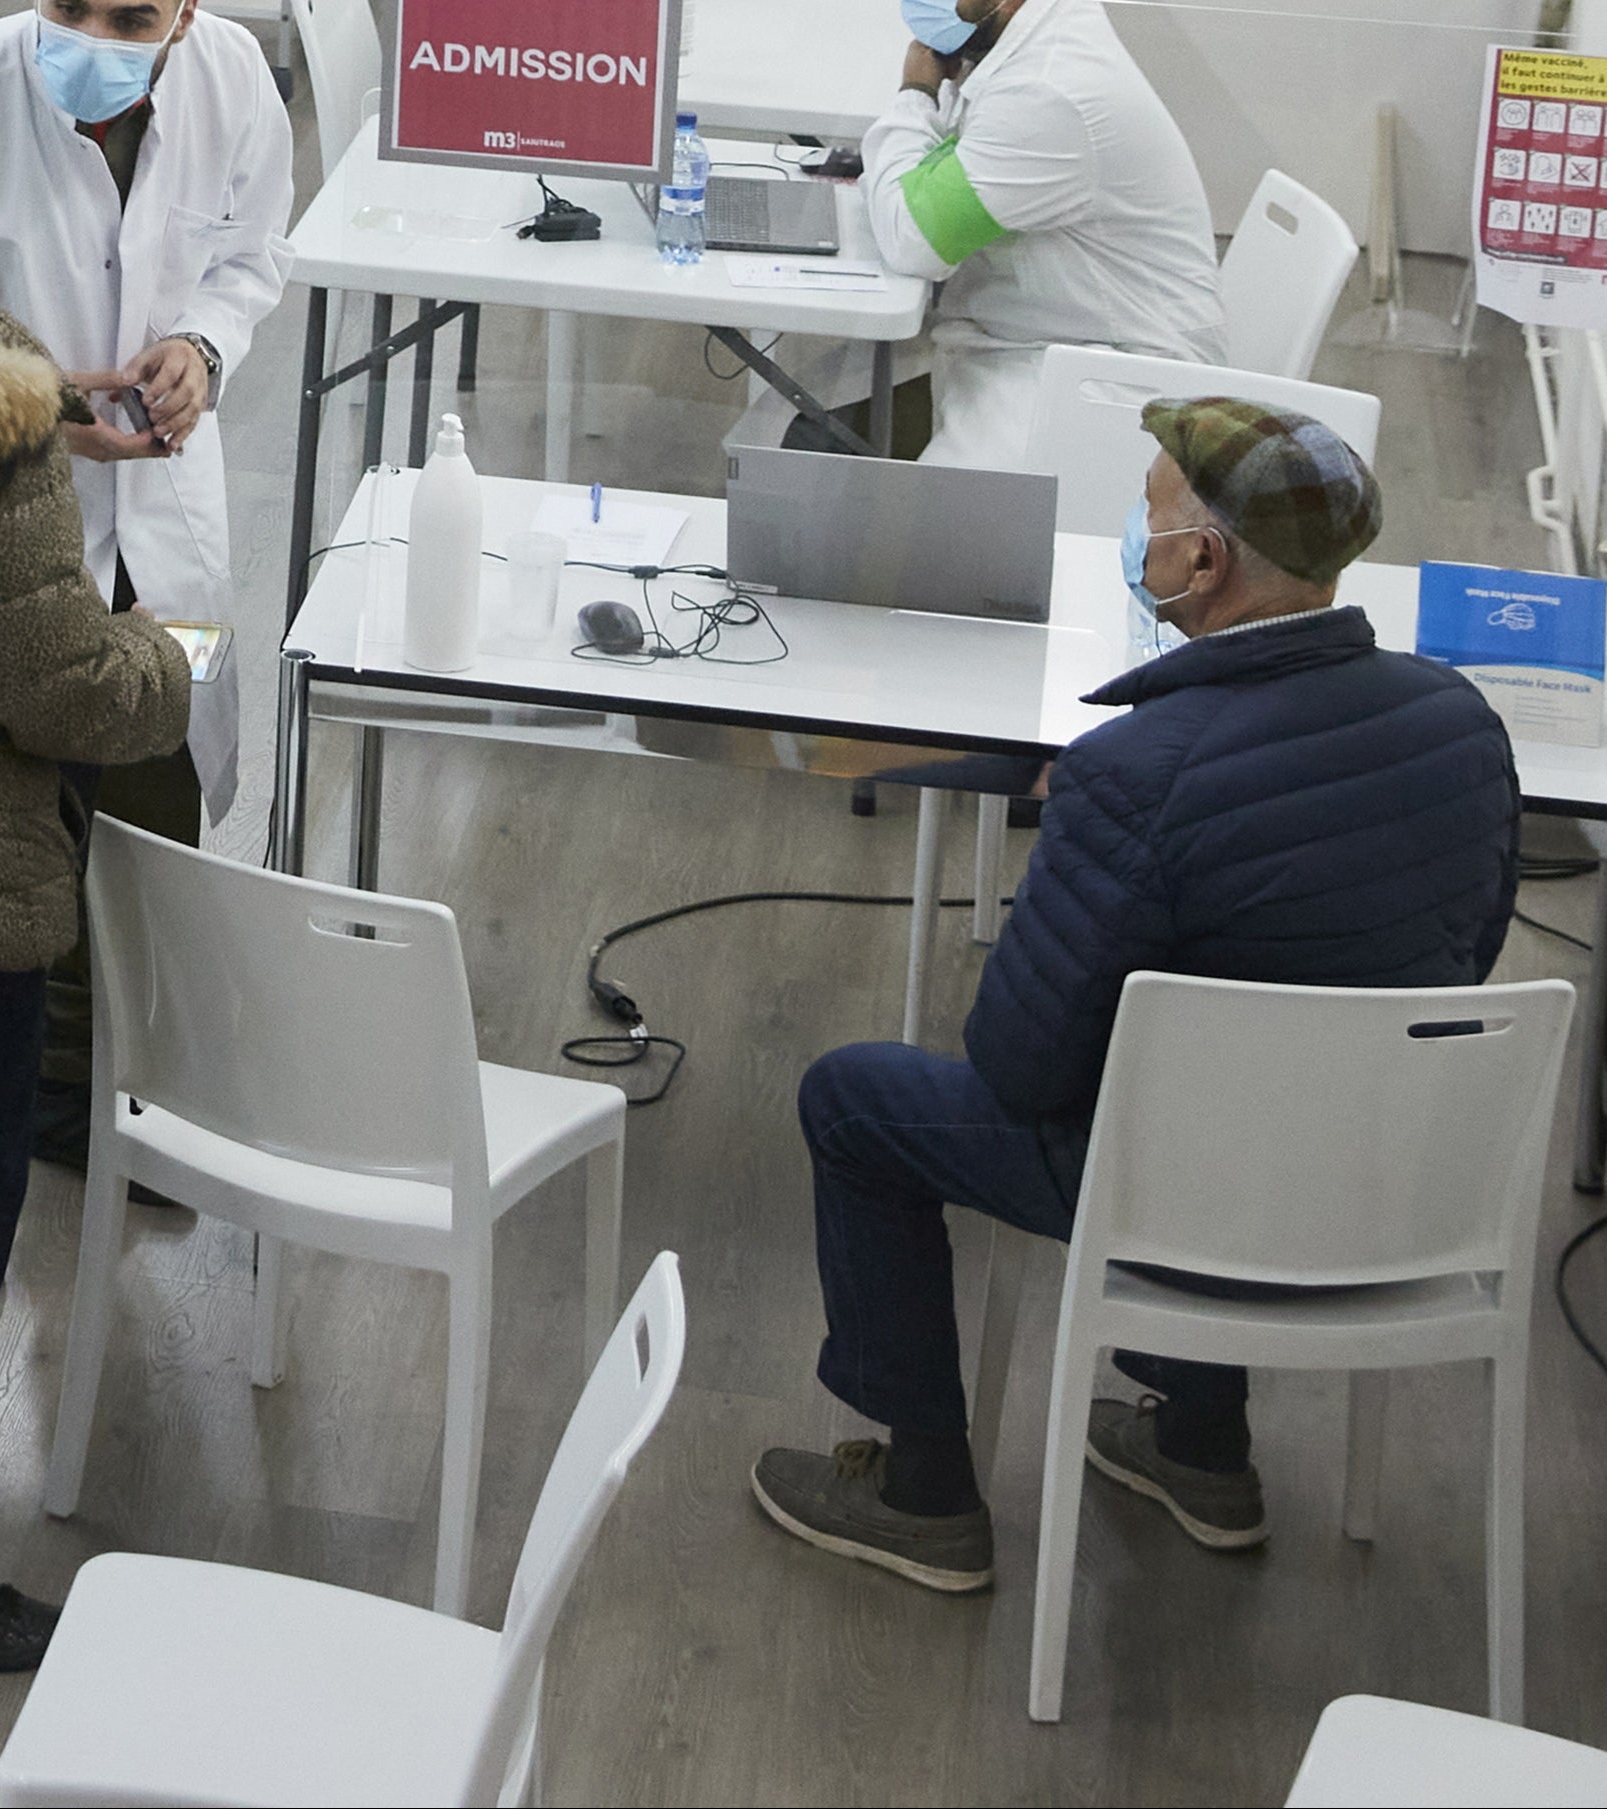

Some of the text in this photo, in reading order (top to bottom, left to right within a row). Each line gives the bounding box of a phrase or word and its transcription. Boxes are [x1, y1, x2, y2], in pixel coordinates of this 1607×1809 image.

[409, 40, 648, 87] ADMISSION
[1504, 53, 1538, 64] Même
[1512, 67, 1536, 77] faut
[1539, 70, 1595, 82] continuer
[1500, 79, 1607, 98] les gestes barrière
[484, 130, 517, 148] m3
[1474, 672, 1592, 694] Disposable Face Mask
